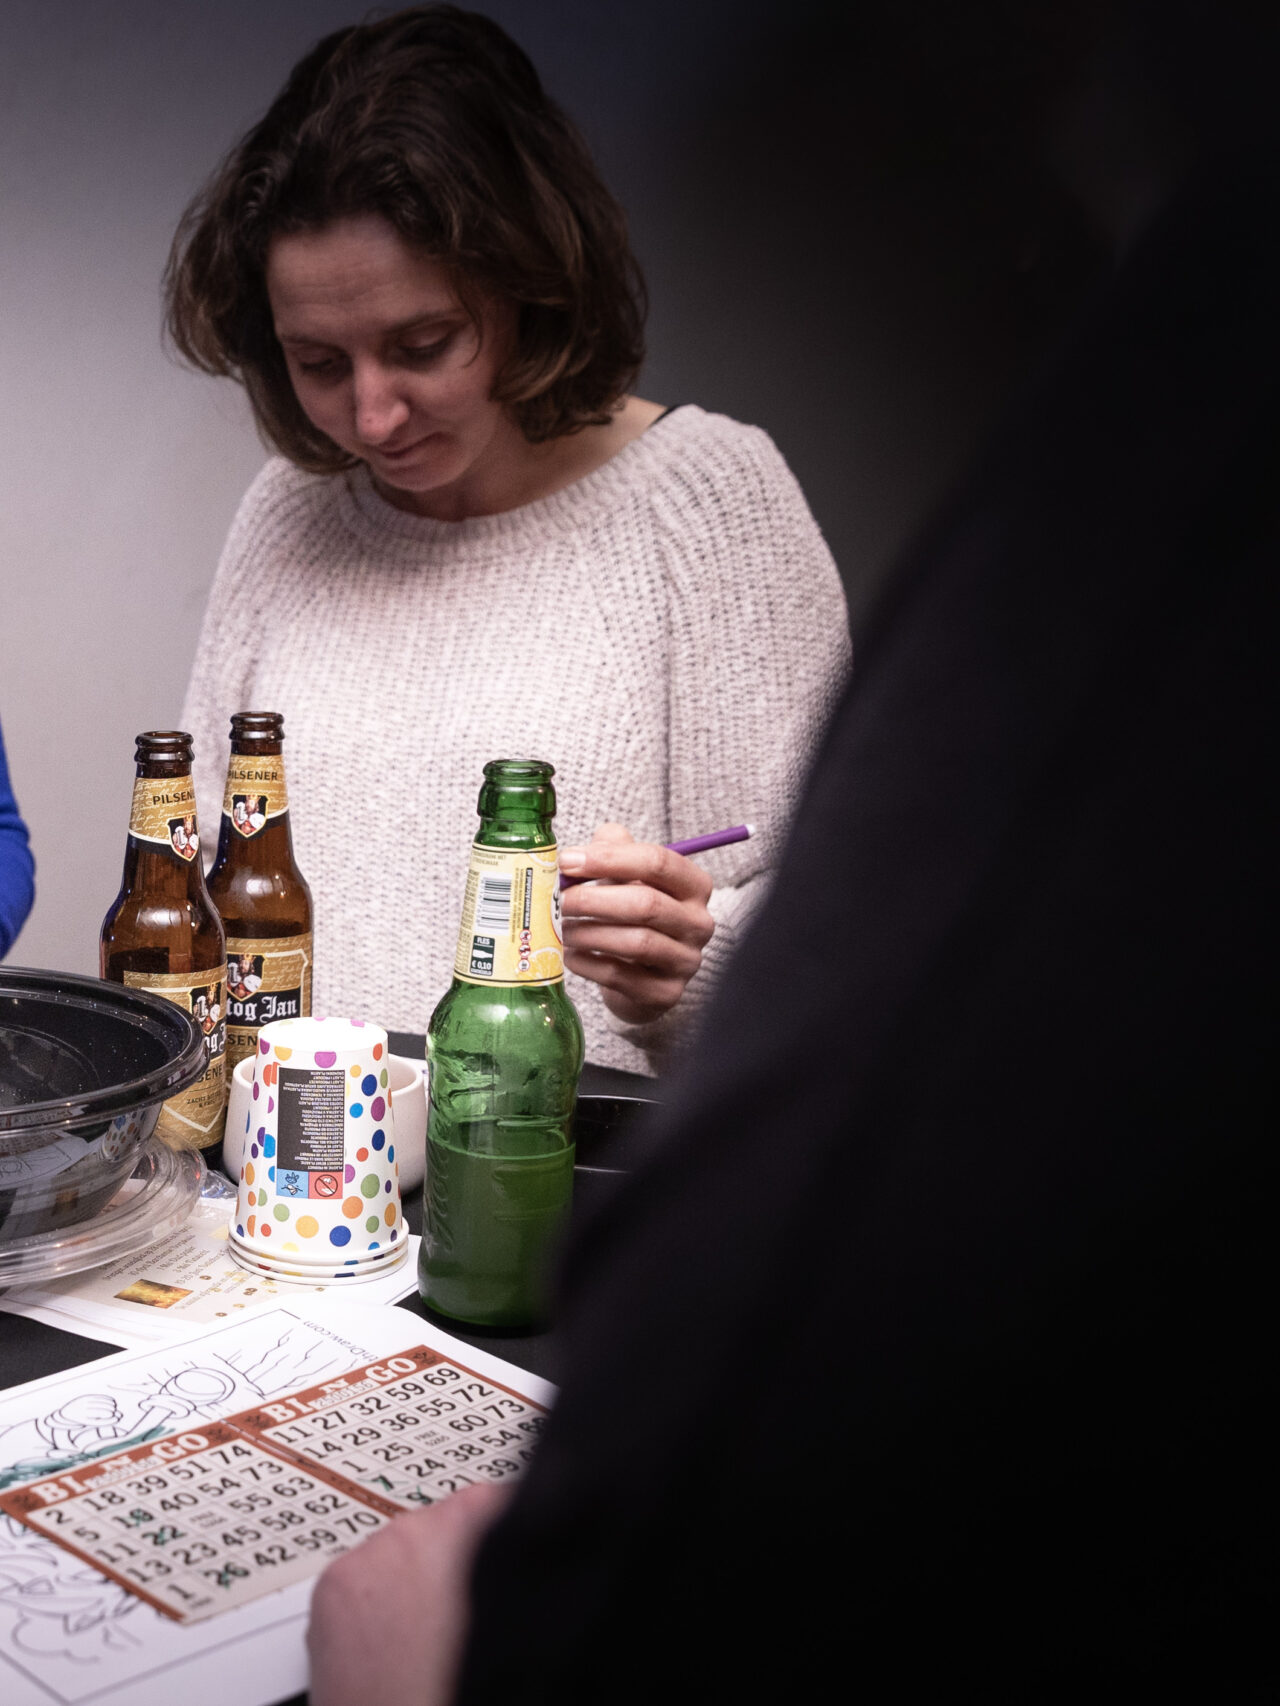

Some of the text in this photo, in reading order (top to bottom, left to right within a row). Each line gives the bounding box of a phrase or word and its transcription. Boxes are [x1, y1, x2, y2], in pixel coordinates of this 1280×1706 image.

[260, 996, 298, 1023] Jan
[272, 1368, 461, 1443] 11 27 32 59 69
[303, 1383, 495, 1459] 14 29 36 55 72
[342, 1460, 368, 1473] 1
[372, 1442, 414, 1462] 25
[448, 1414, 489, 1432] 60
[482, 1399, 525, 1419] 73
[46, 1509, 72, 1524] 2
[84, 1491, 125, 1511] 18
[127, 1475, 168, 1495] 39
[168, 1460, 211, 1480] 51
[210, 1445, 252, 1464] 74
[404, 1457, 447, 1478] 24
[443, 1443, 485, 1463] 38
[479, 1429, 523, 1448] 54
[477, 1457, 520, 1478] 39
[74, 1527, 100, 1541] 5
[161, 1492, 198, 1511] 40
[197, 1477, 241, 1496] 54
[240, 1460, 283, 1481] 73
[96, 1543, 138, 1563] 11
[228, 1493, 272, 1513] 55
[273, 1477, 315, 1497] 63
[127, 1494, 349, 1582] 13 23 45 58 62
[168, 1584, 194, 1599] 1
[254, 1545, 297, 1566] 42
[292, 1529, 338, 1550] 59
[334, 1511, 381, 1533] 70
